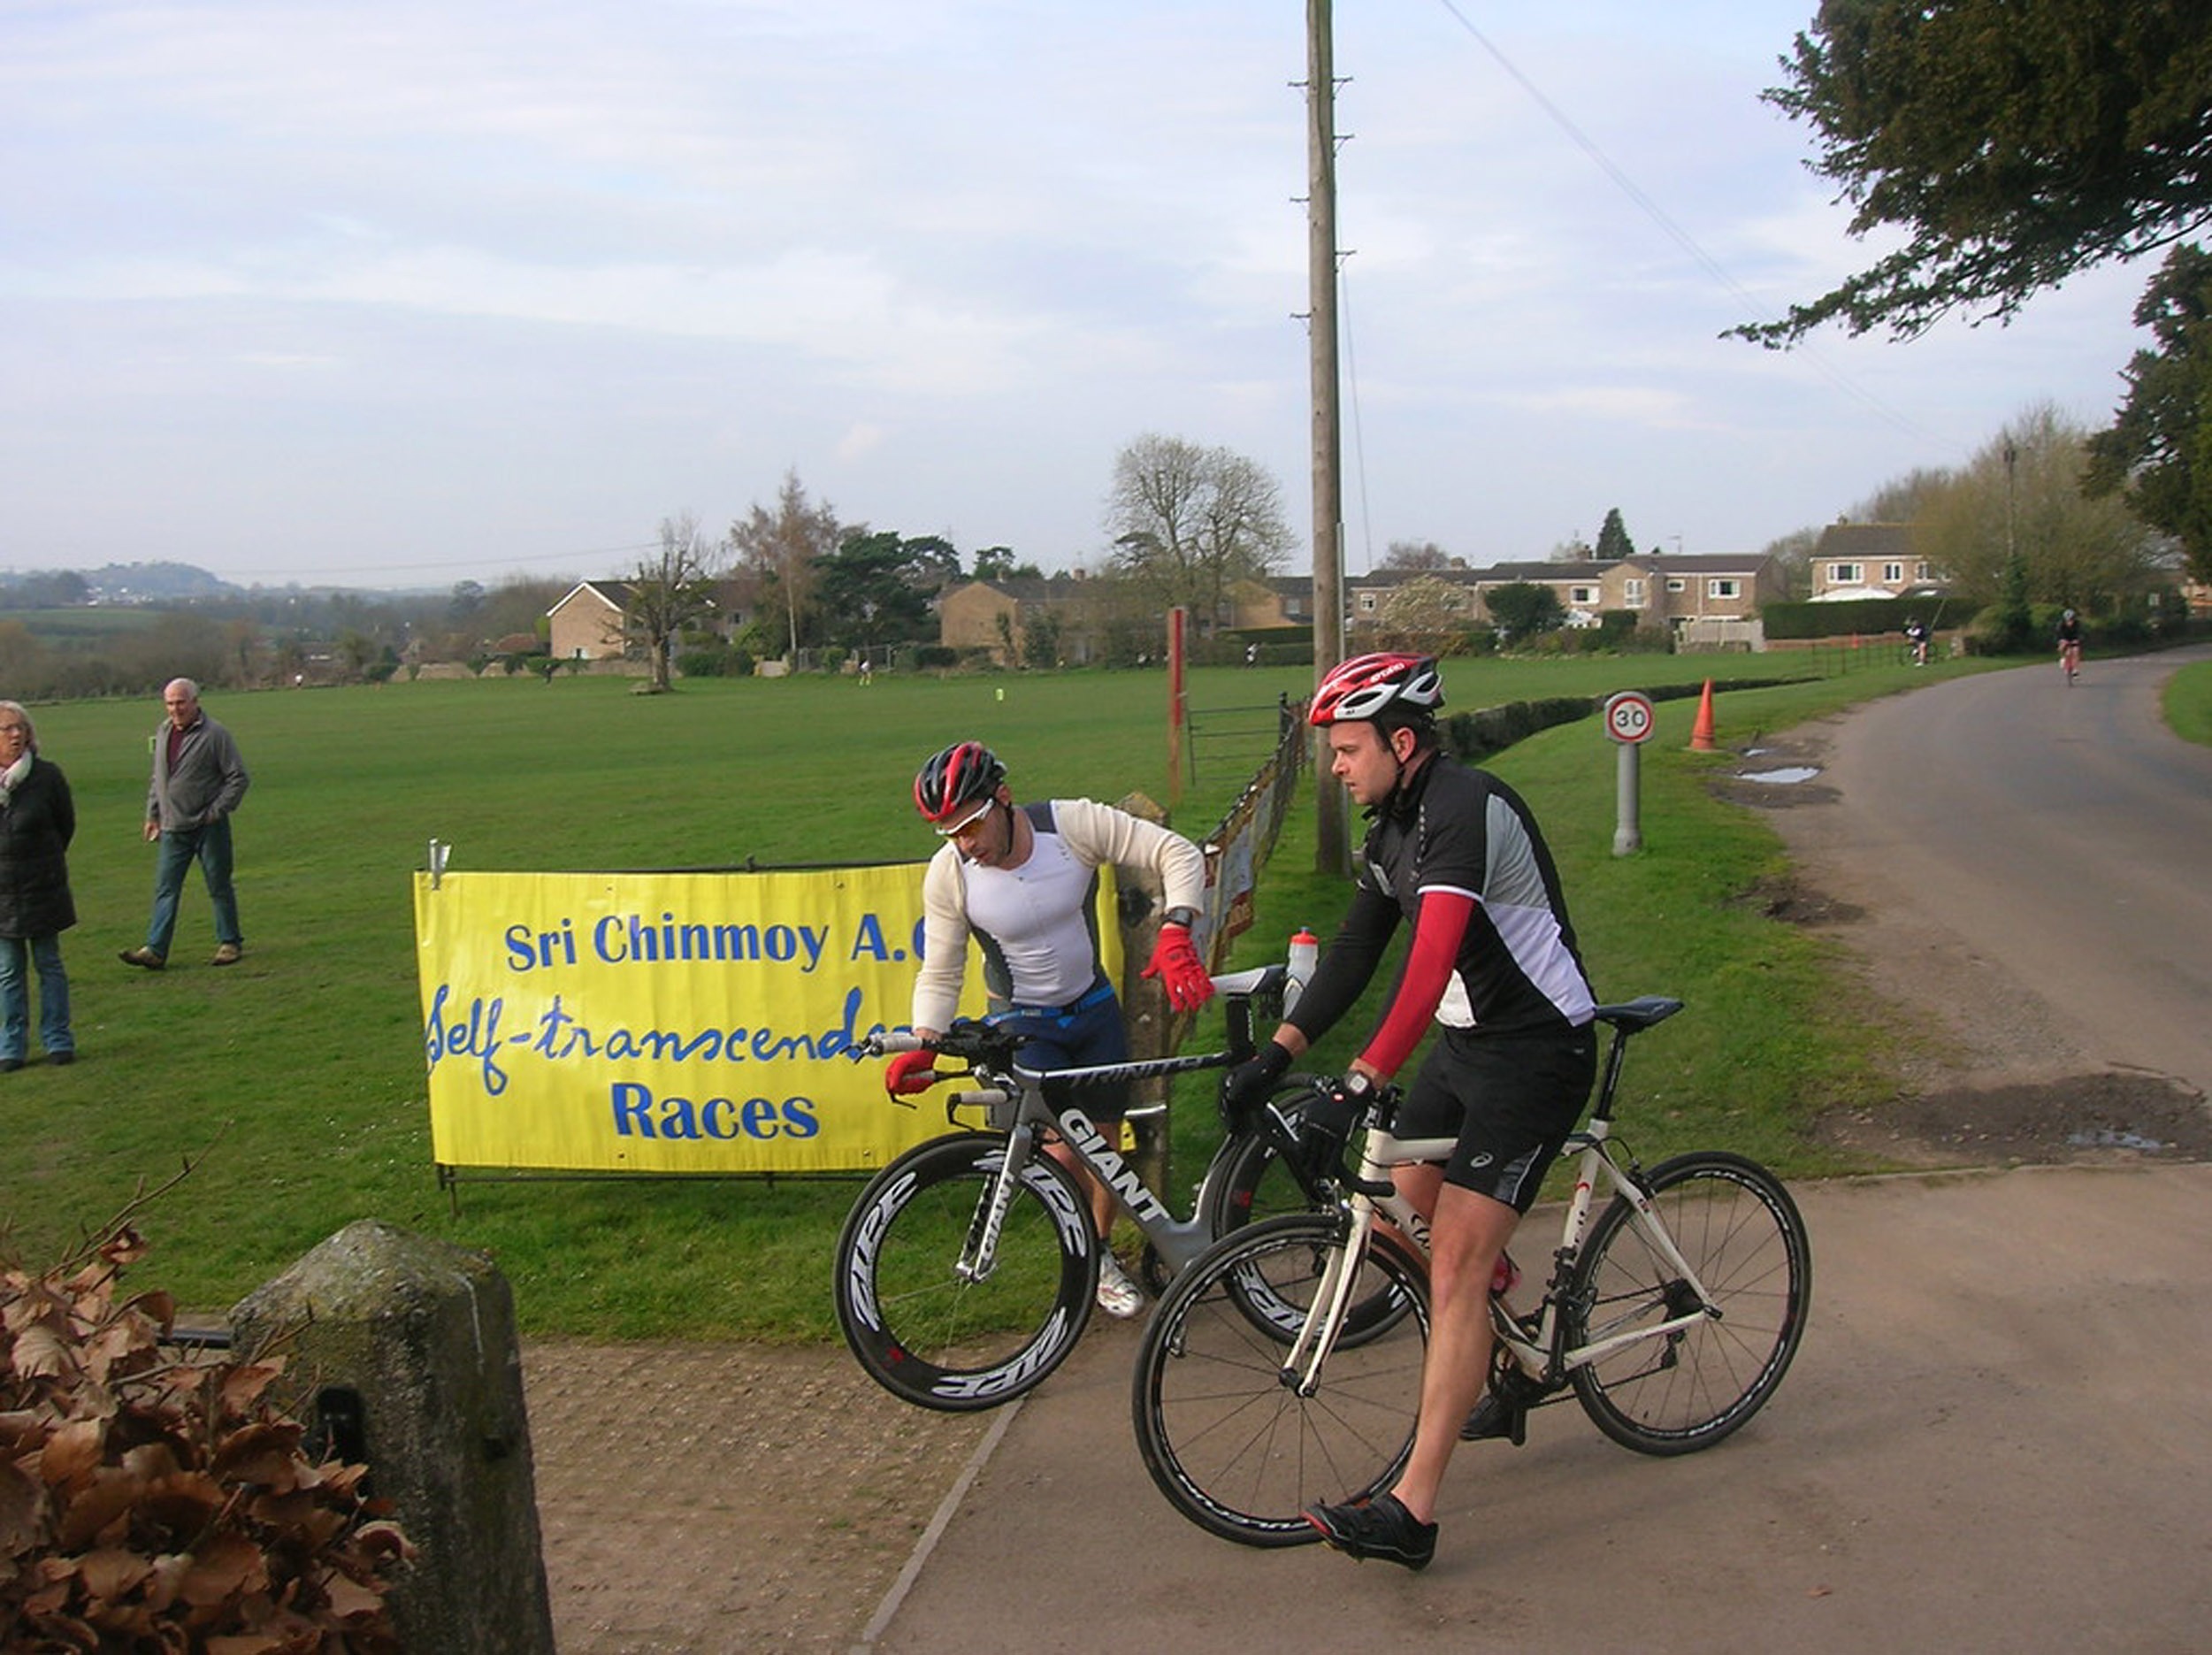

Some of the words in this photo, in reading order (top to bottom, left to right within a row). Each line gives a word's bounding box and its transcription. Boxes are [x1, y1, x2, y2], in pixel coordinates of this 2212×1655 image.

[1616, 710, 1646, 727] 30
[505, 917, 577, 972] Sri
[594, 912, 829, 973] Chinmoy
[611, 1082, 820, 1140] Races
[1060, 1108, 1170, 1222] GIANT
[851, 1171, 919, 1332] ZIPP
[980, 1169, 1015, 1262] GIANT
[931, 1306, 1068, 1398] ZIPP
